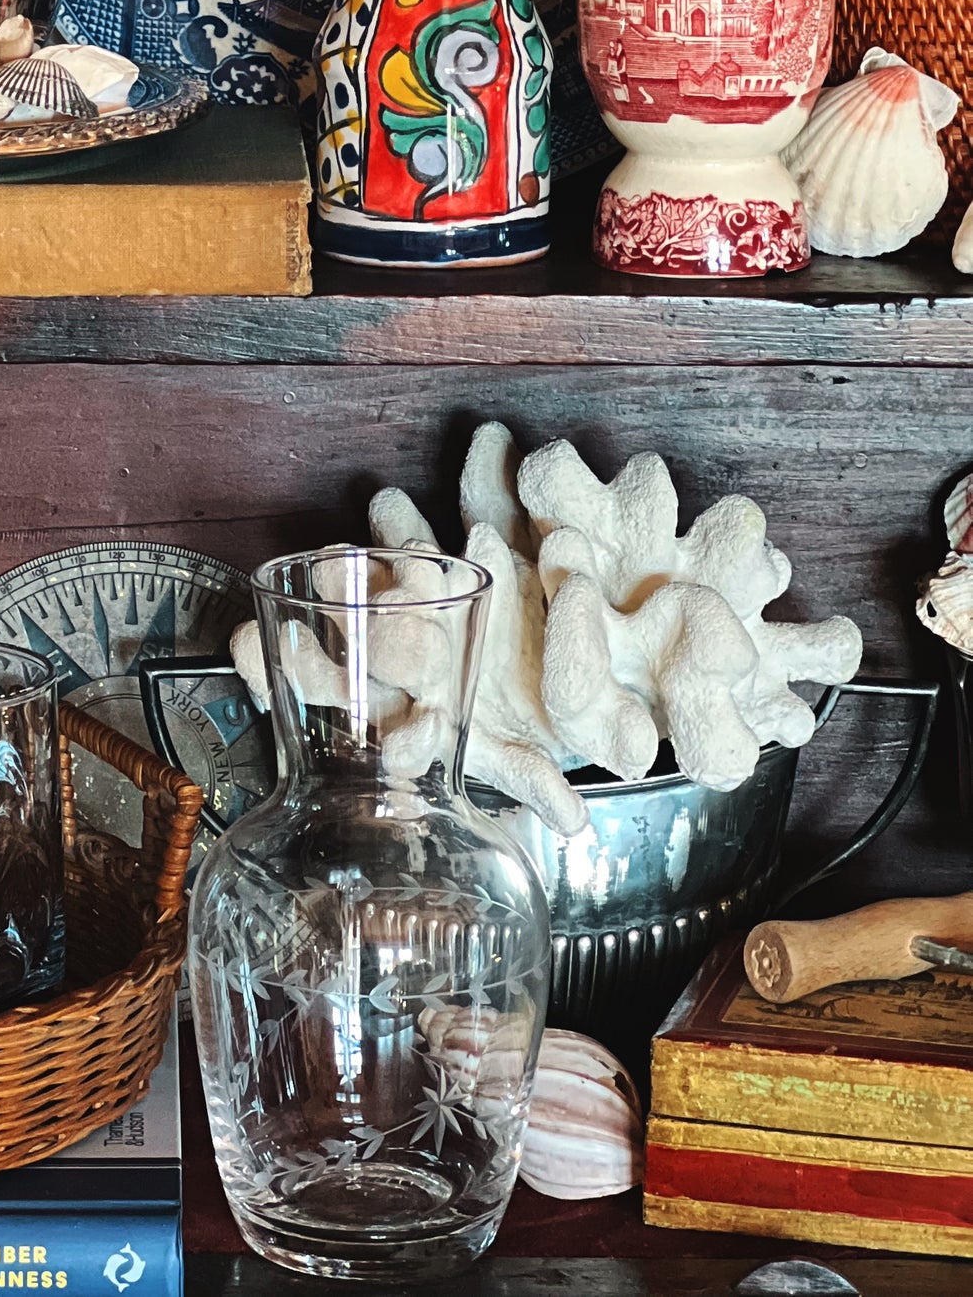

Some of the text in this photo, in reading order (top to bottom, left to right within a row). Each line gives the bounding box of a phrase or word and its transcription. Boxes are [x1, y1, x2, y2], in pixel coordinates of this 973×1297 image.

[70, 555, 87, 565] 110
[109, 551, 126, 560] 120
[148, 552, 166, 563] 130
[31, 566, 49, 578] 100
[186, 560, 204, 572] 140
[0, 583, 13, 595] 90
[165, 688, 231, 783] NEW YORK
